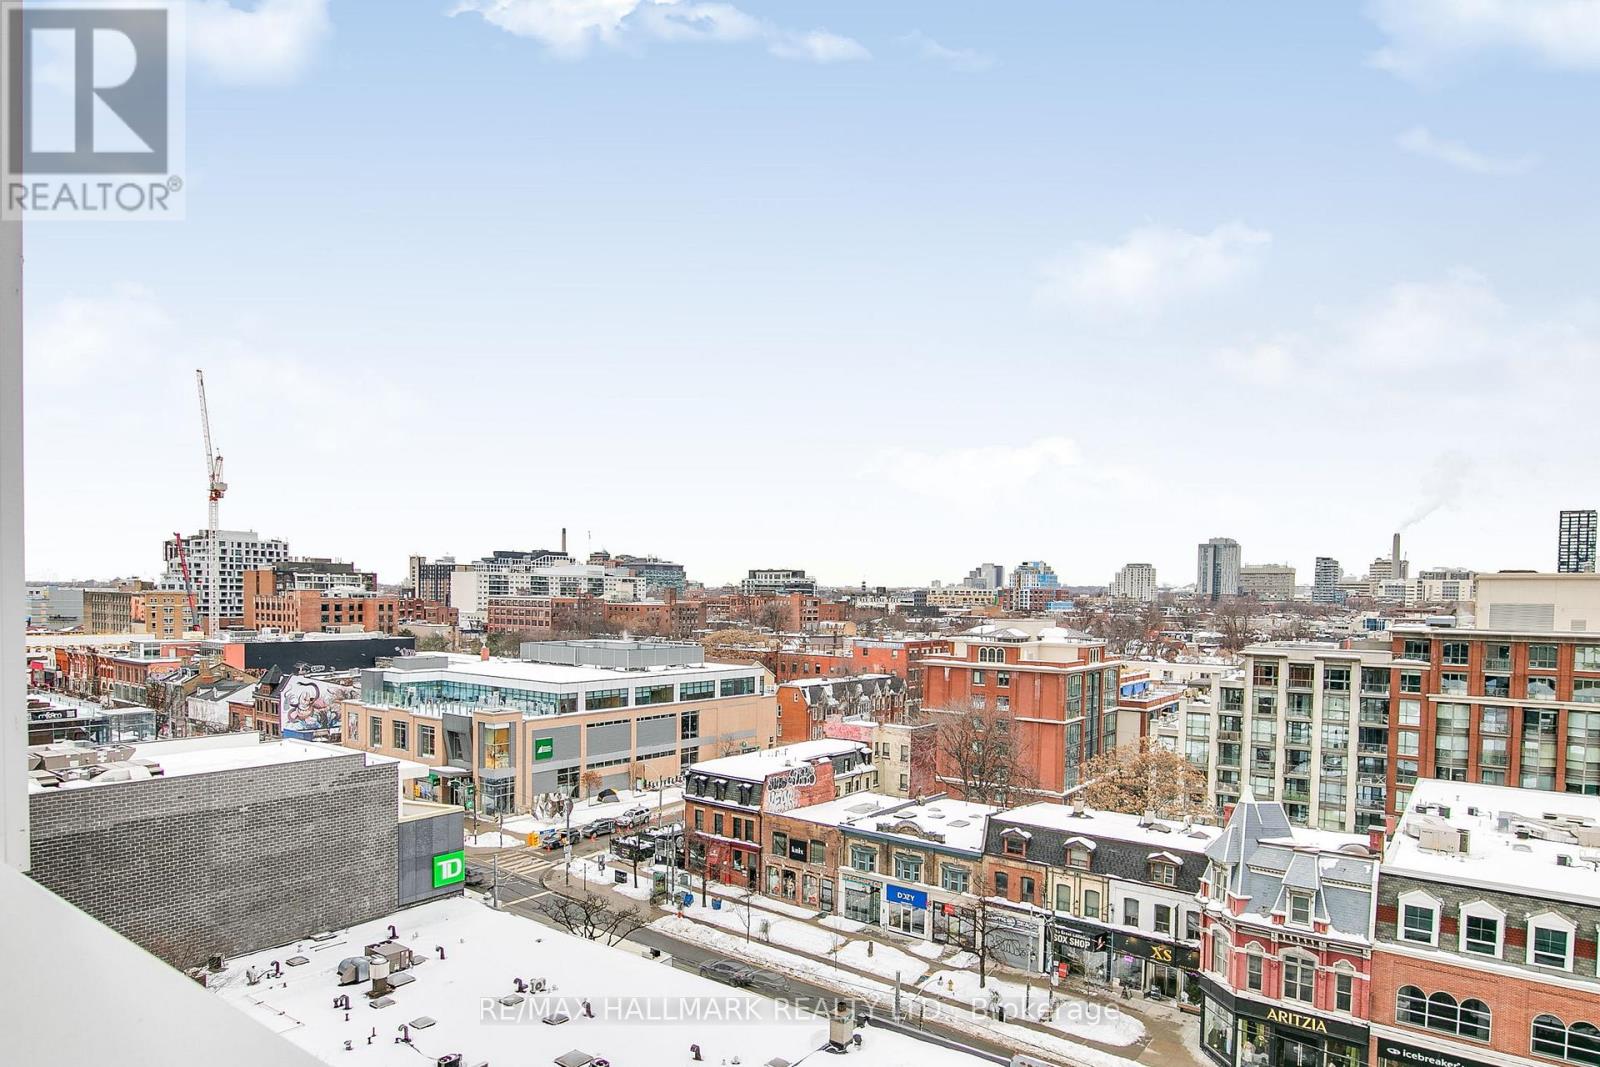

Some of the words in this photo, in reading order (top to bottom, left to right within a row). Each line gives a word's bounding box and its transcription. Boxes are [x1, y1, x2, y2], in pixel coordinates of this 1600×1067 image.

[437, 858, 462, 880] TD
[1053, 934, 1069, 944] SOX
[1069, 938, 1091, 949] SHOP
[1151, 946, 1173, 962] XS
[1266, 1008, 1328, 1034] ARITZIA
